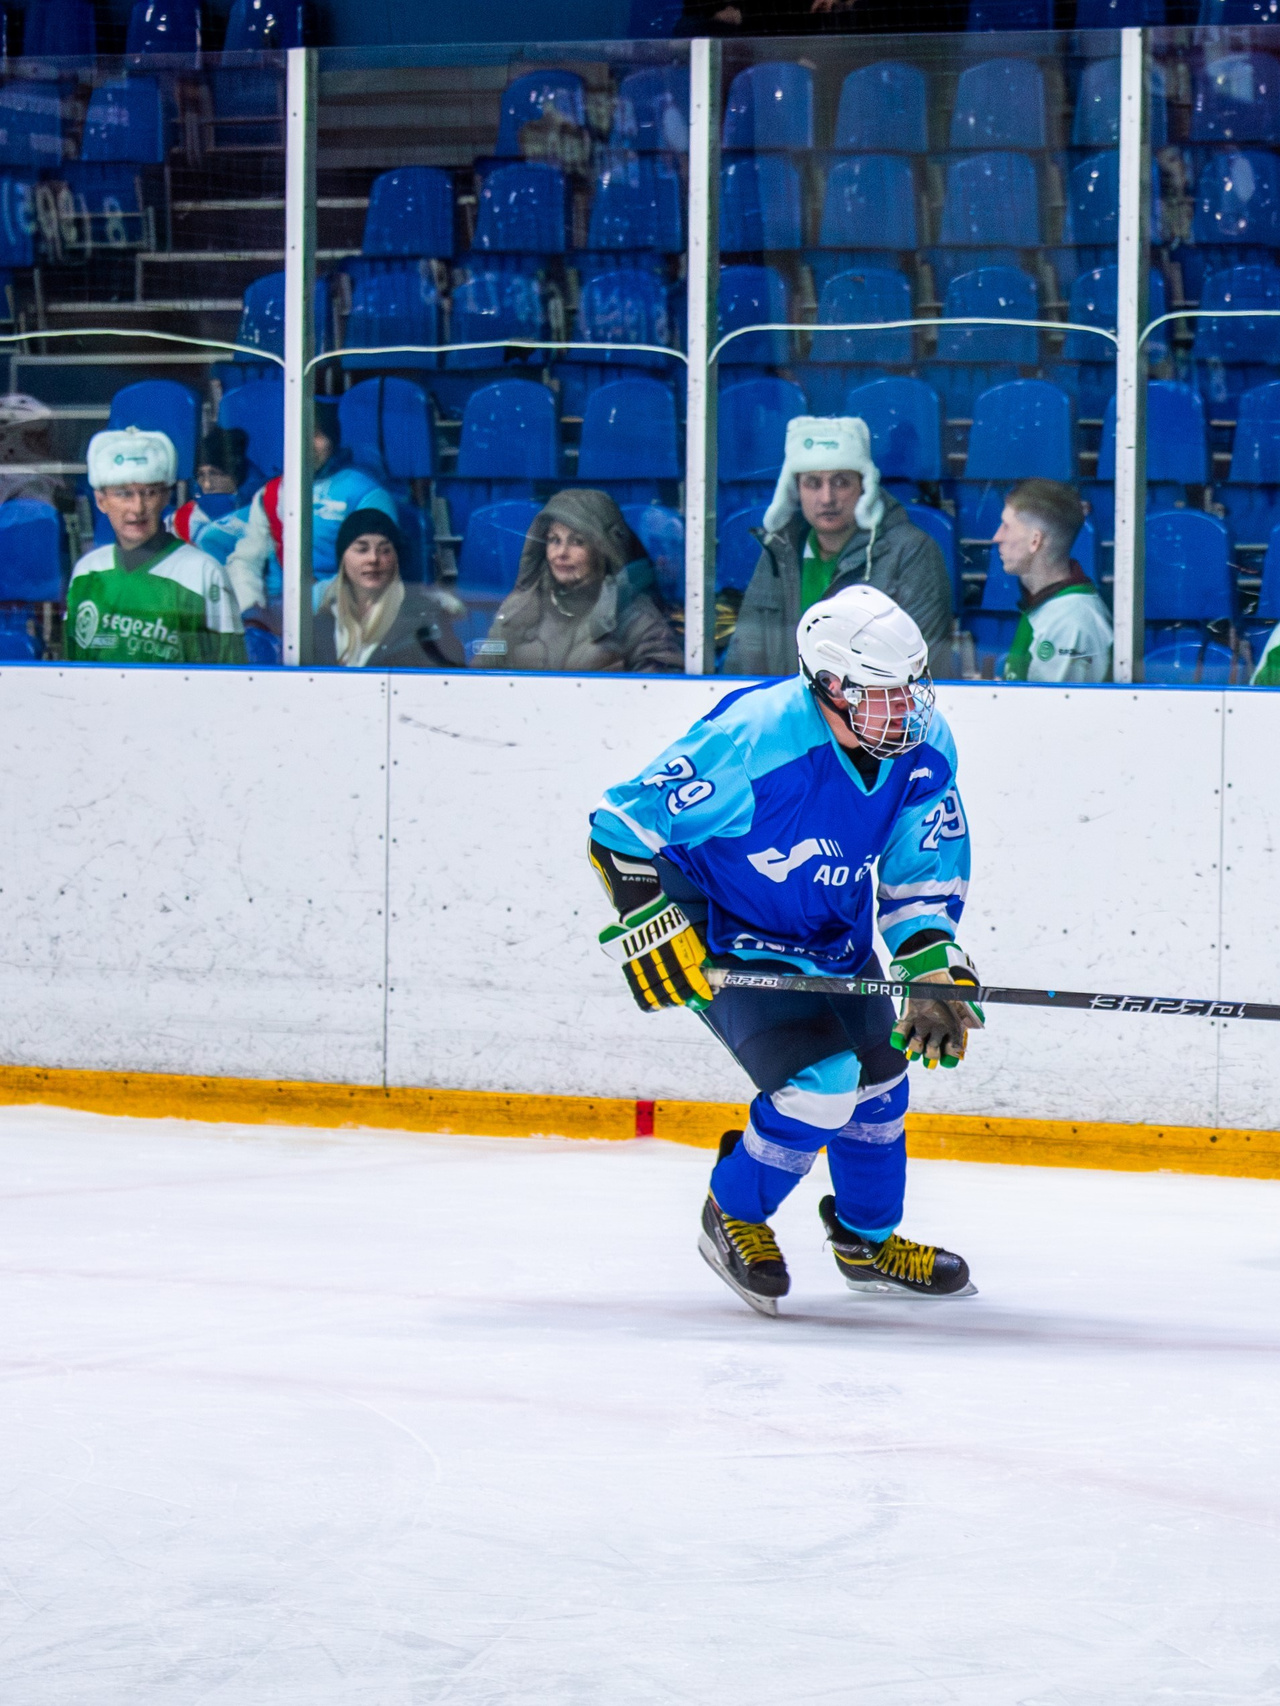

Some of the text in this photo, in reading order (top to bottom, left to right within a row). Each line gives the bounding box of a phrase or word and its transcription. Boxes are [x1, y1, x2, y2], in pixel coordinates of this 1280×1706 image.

[102, 612, 179, 645] segezha
[640, 754, 716, 818] 29
[919, 786, 967, 853] 29
[622, 905, 687, 958] WARR
